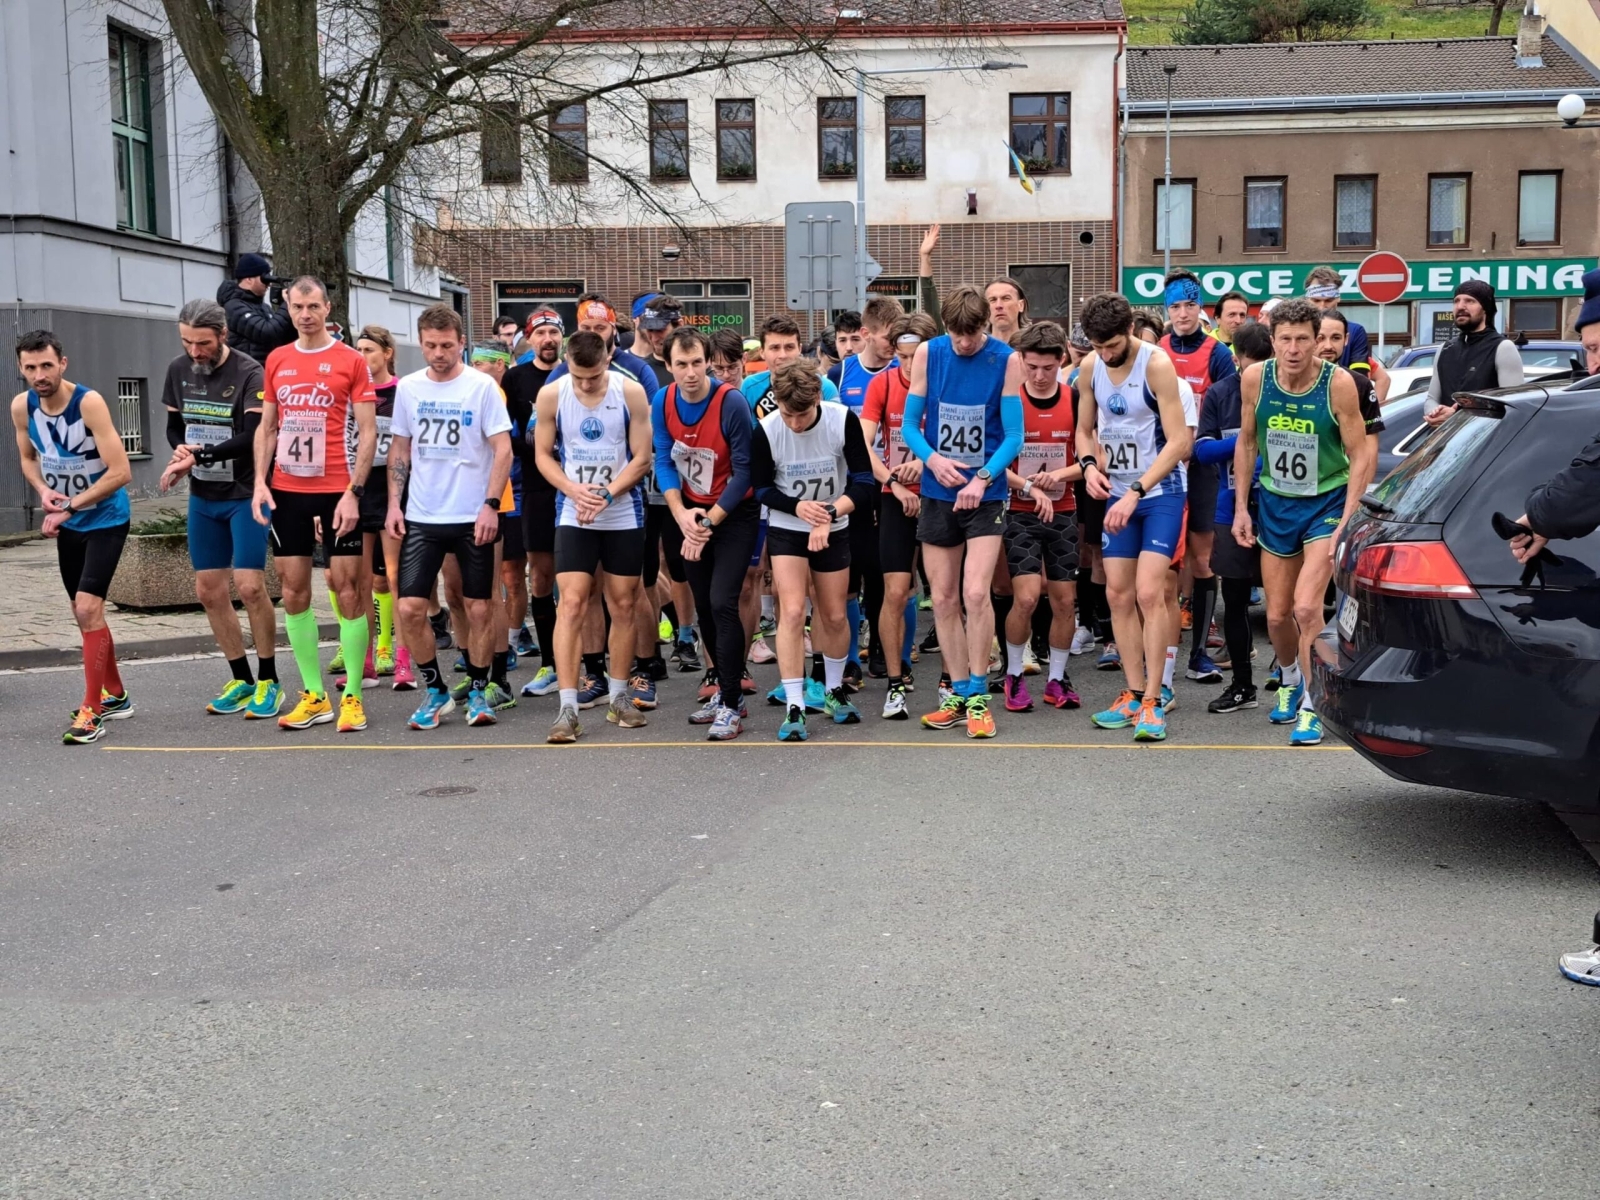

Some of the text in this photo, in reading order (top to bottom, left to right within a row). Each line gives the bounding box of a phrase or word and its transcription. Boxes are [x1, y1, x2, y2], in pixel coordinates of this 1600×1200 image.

[1134, 270, 1294, 298] OOCE
[1337, 264, 1586, 293] ZLENINA
[681, 314, 743, 325] NESS FOOD
[698, 325, 722, 335] EN
[277, 384, 334, 408] Carla
[183, 402, 232, 417] BARCELONA
[283, 408, 328, 418] Chocolates
[940, 405, 958, 414] ZIMNÍ
[187, 426, 206, 434] ZIMNÍ
[418, 417, 460, 446] 278
[1267, 412, 1315, 435] eleven
[1268, 430, 1289, 439] ZIMNÍ
[940, 423, 983, 453] 243
[1299, 442, 1316, 450] LIGA
[287, 436, 314, 463] 41
[1105, 443, 1138, 470] 247
[575, 465, 613, 487] 173
[684, 456, 703, 485] 12
[786, 462, 808, 471] ZIMNÍ
[819, 466, 835, 474] LIGA
[1274, 450, 1308, 481] 46
[45, 473, 90, 498] 279
[792, 476, 835, 501] 271
